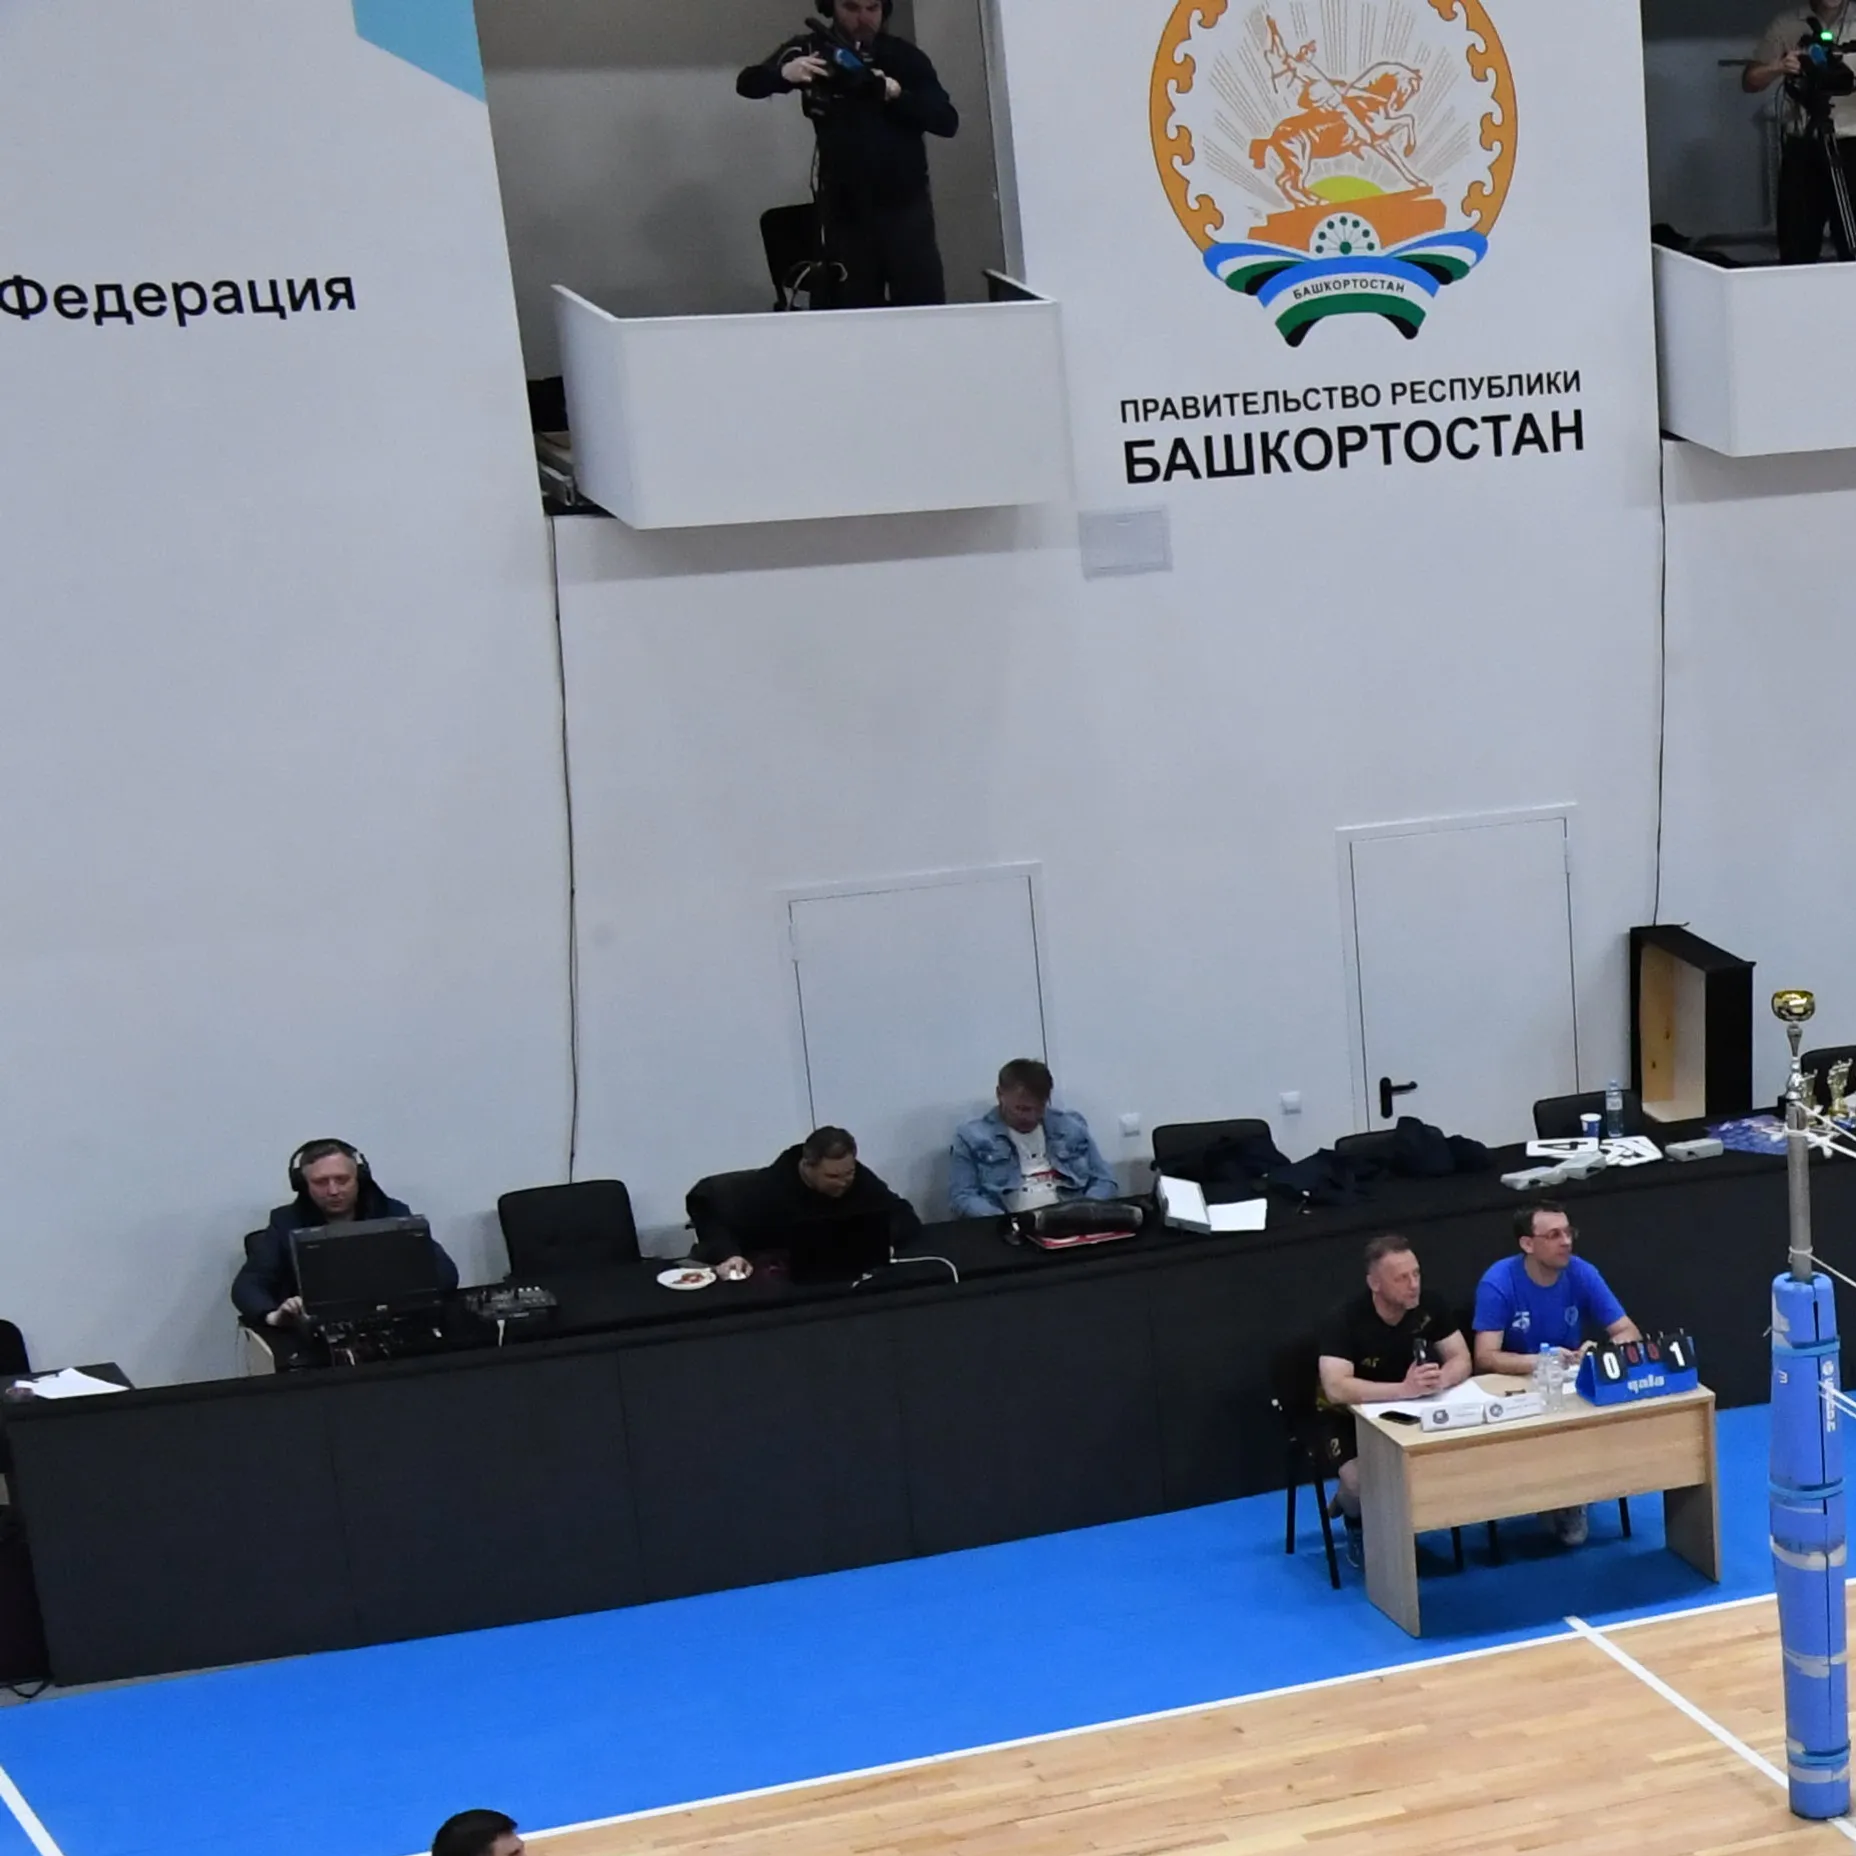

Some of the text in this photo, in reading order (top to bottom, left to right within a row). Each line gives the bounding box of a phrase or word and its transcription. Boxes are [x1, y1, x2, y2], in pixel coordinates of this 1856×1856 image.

[0, 275, 356, 327] Федерация
[1292, 278, 1405, 300] БАШКОРТОСТАН
[1120, 370, 1582, 424] ПРАВИТЕЛЬСТВО РЕСПУБЛИКИ
[1124, 409, 1585, 485] БАШКОРТОСТАН
[1602, 1351, 1621, 1379] 0
[1669, 1340, 1685, 1367] 1
